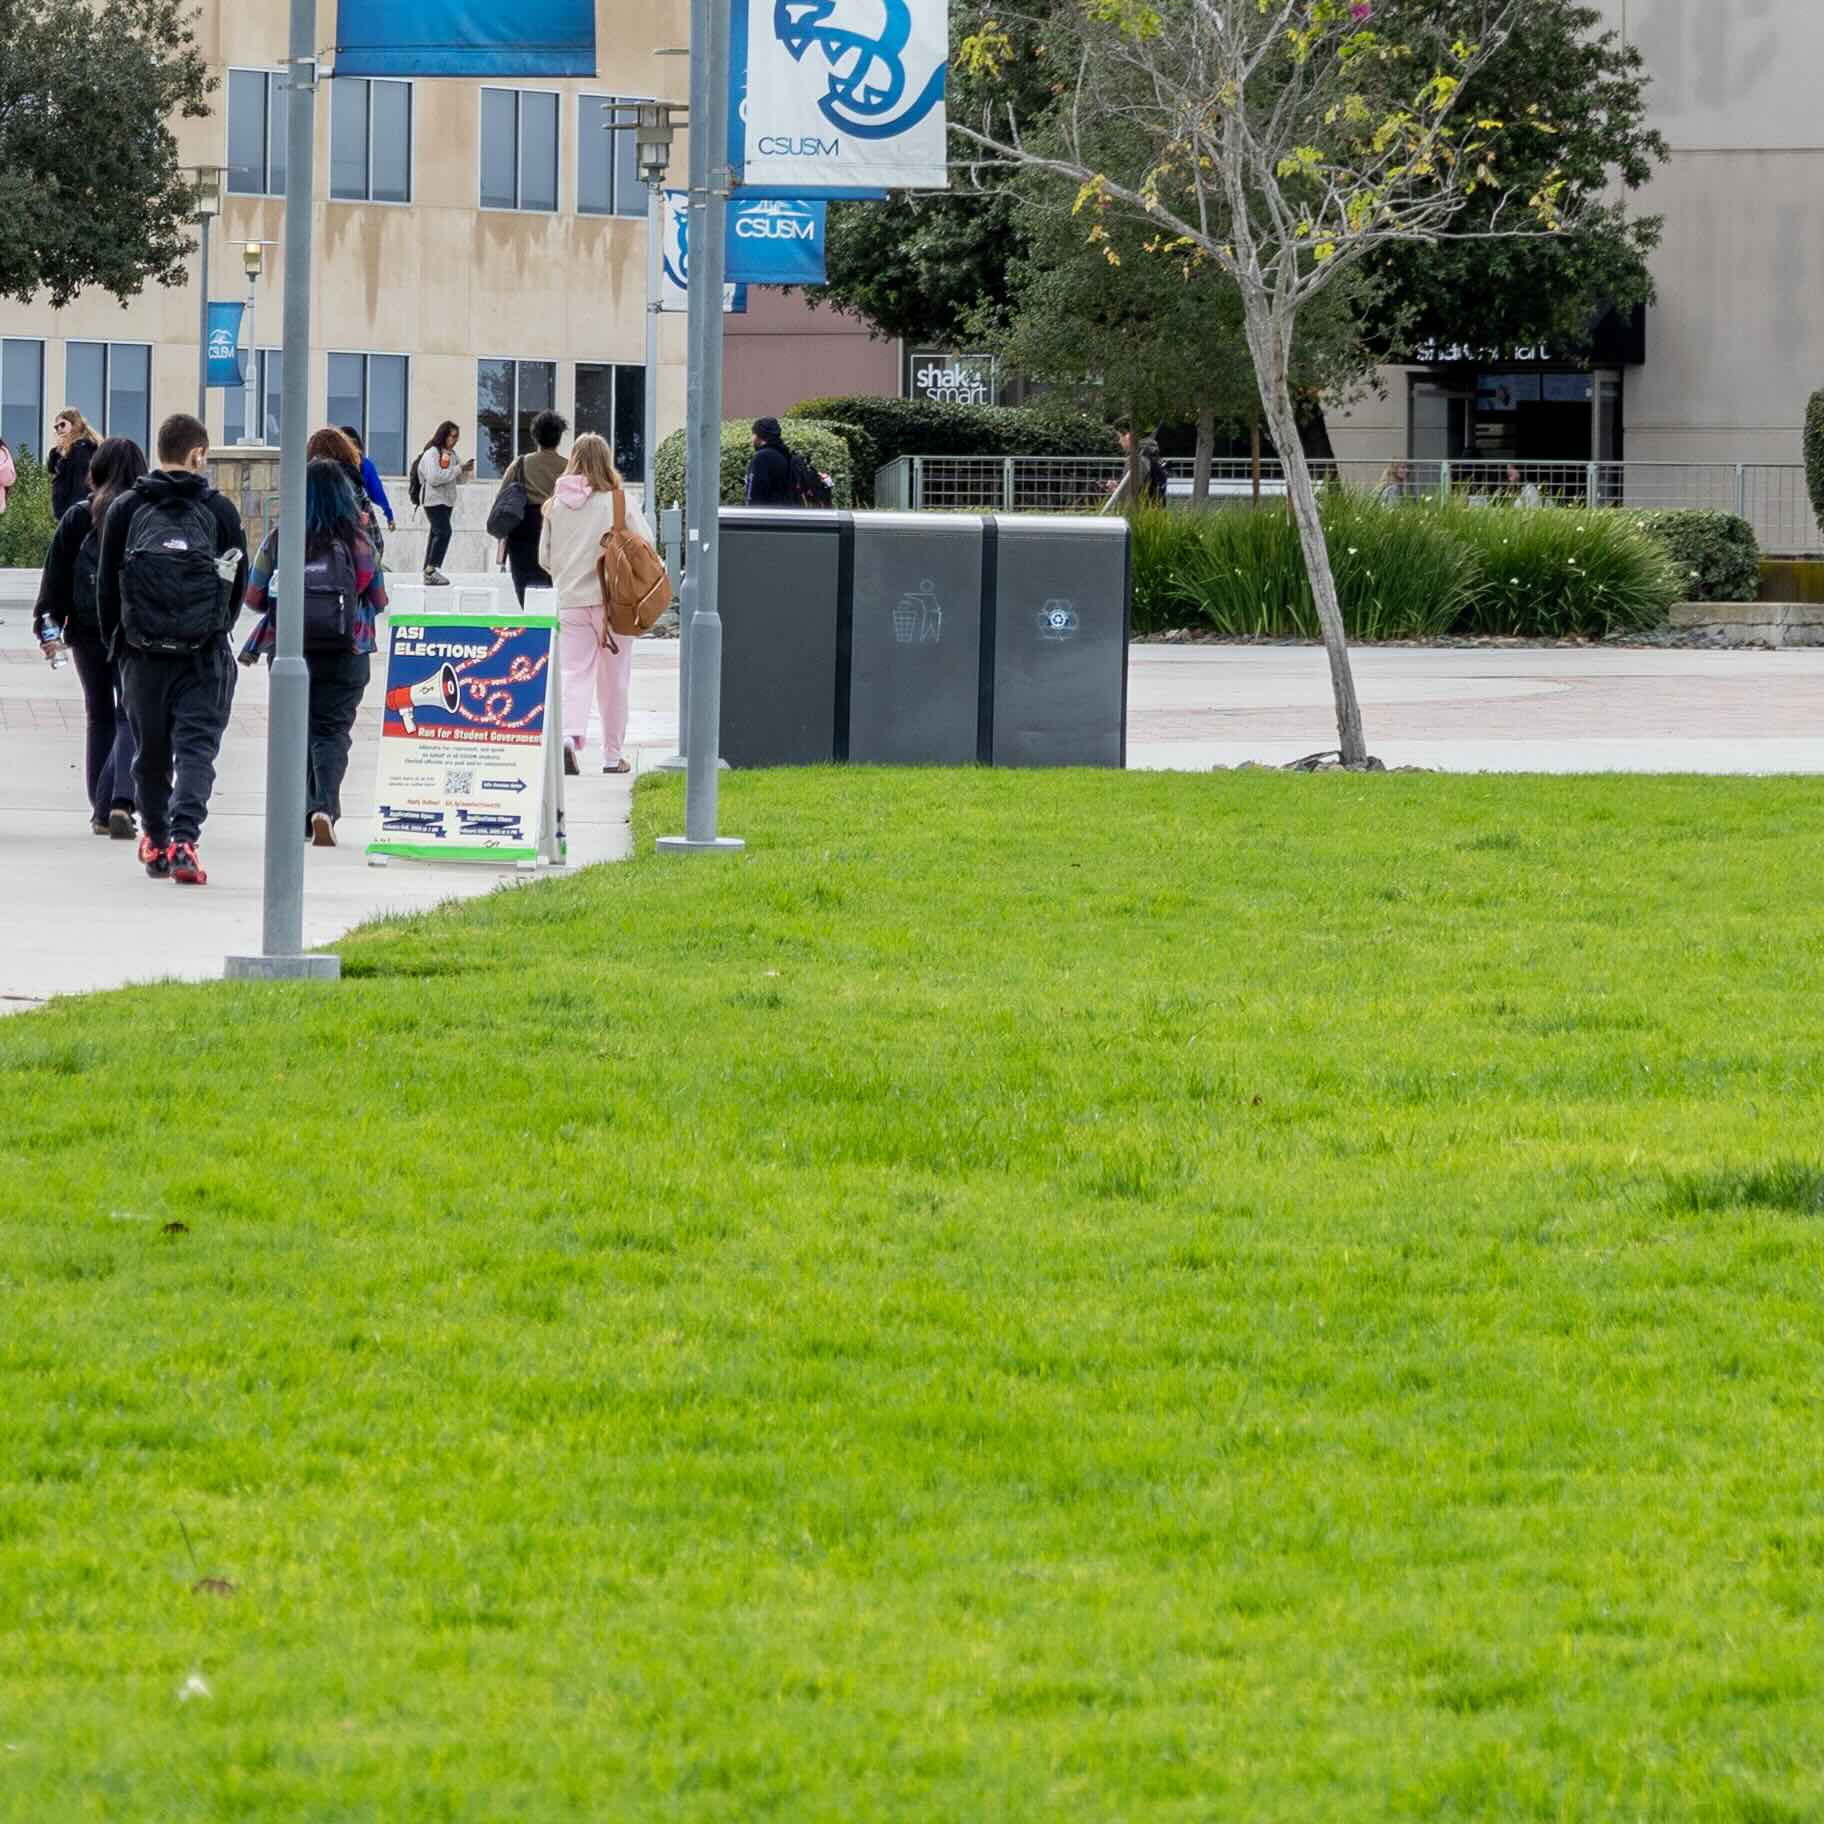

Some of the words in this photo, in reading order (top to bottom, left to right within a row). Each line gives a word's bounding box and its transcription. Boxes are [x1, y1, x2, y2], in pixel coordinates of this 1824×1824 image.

[758, 136, 839, 158] CSUSM
[735, 217, 815, 240] CSUSM
[916, 362, 981, 388] shake
[926, 382, 987, 406] smart
[395, 626, 425, 640] ASI
[394, 642, 489, 659] ELECTIONS
[418, 727, 435, 738] Run
[437, 727, 453, 739] for
[454, 728, 489, 742] Student
